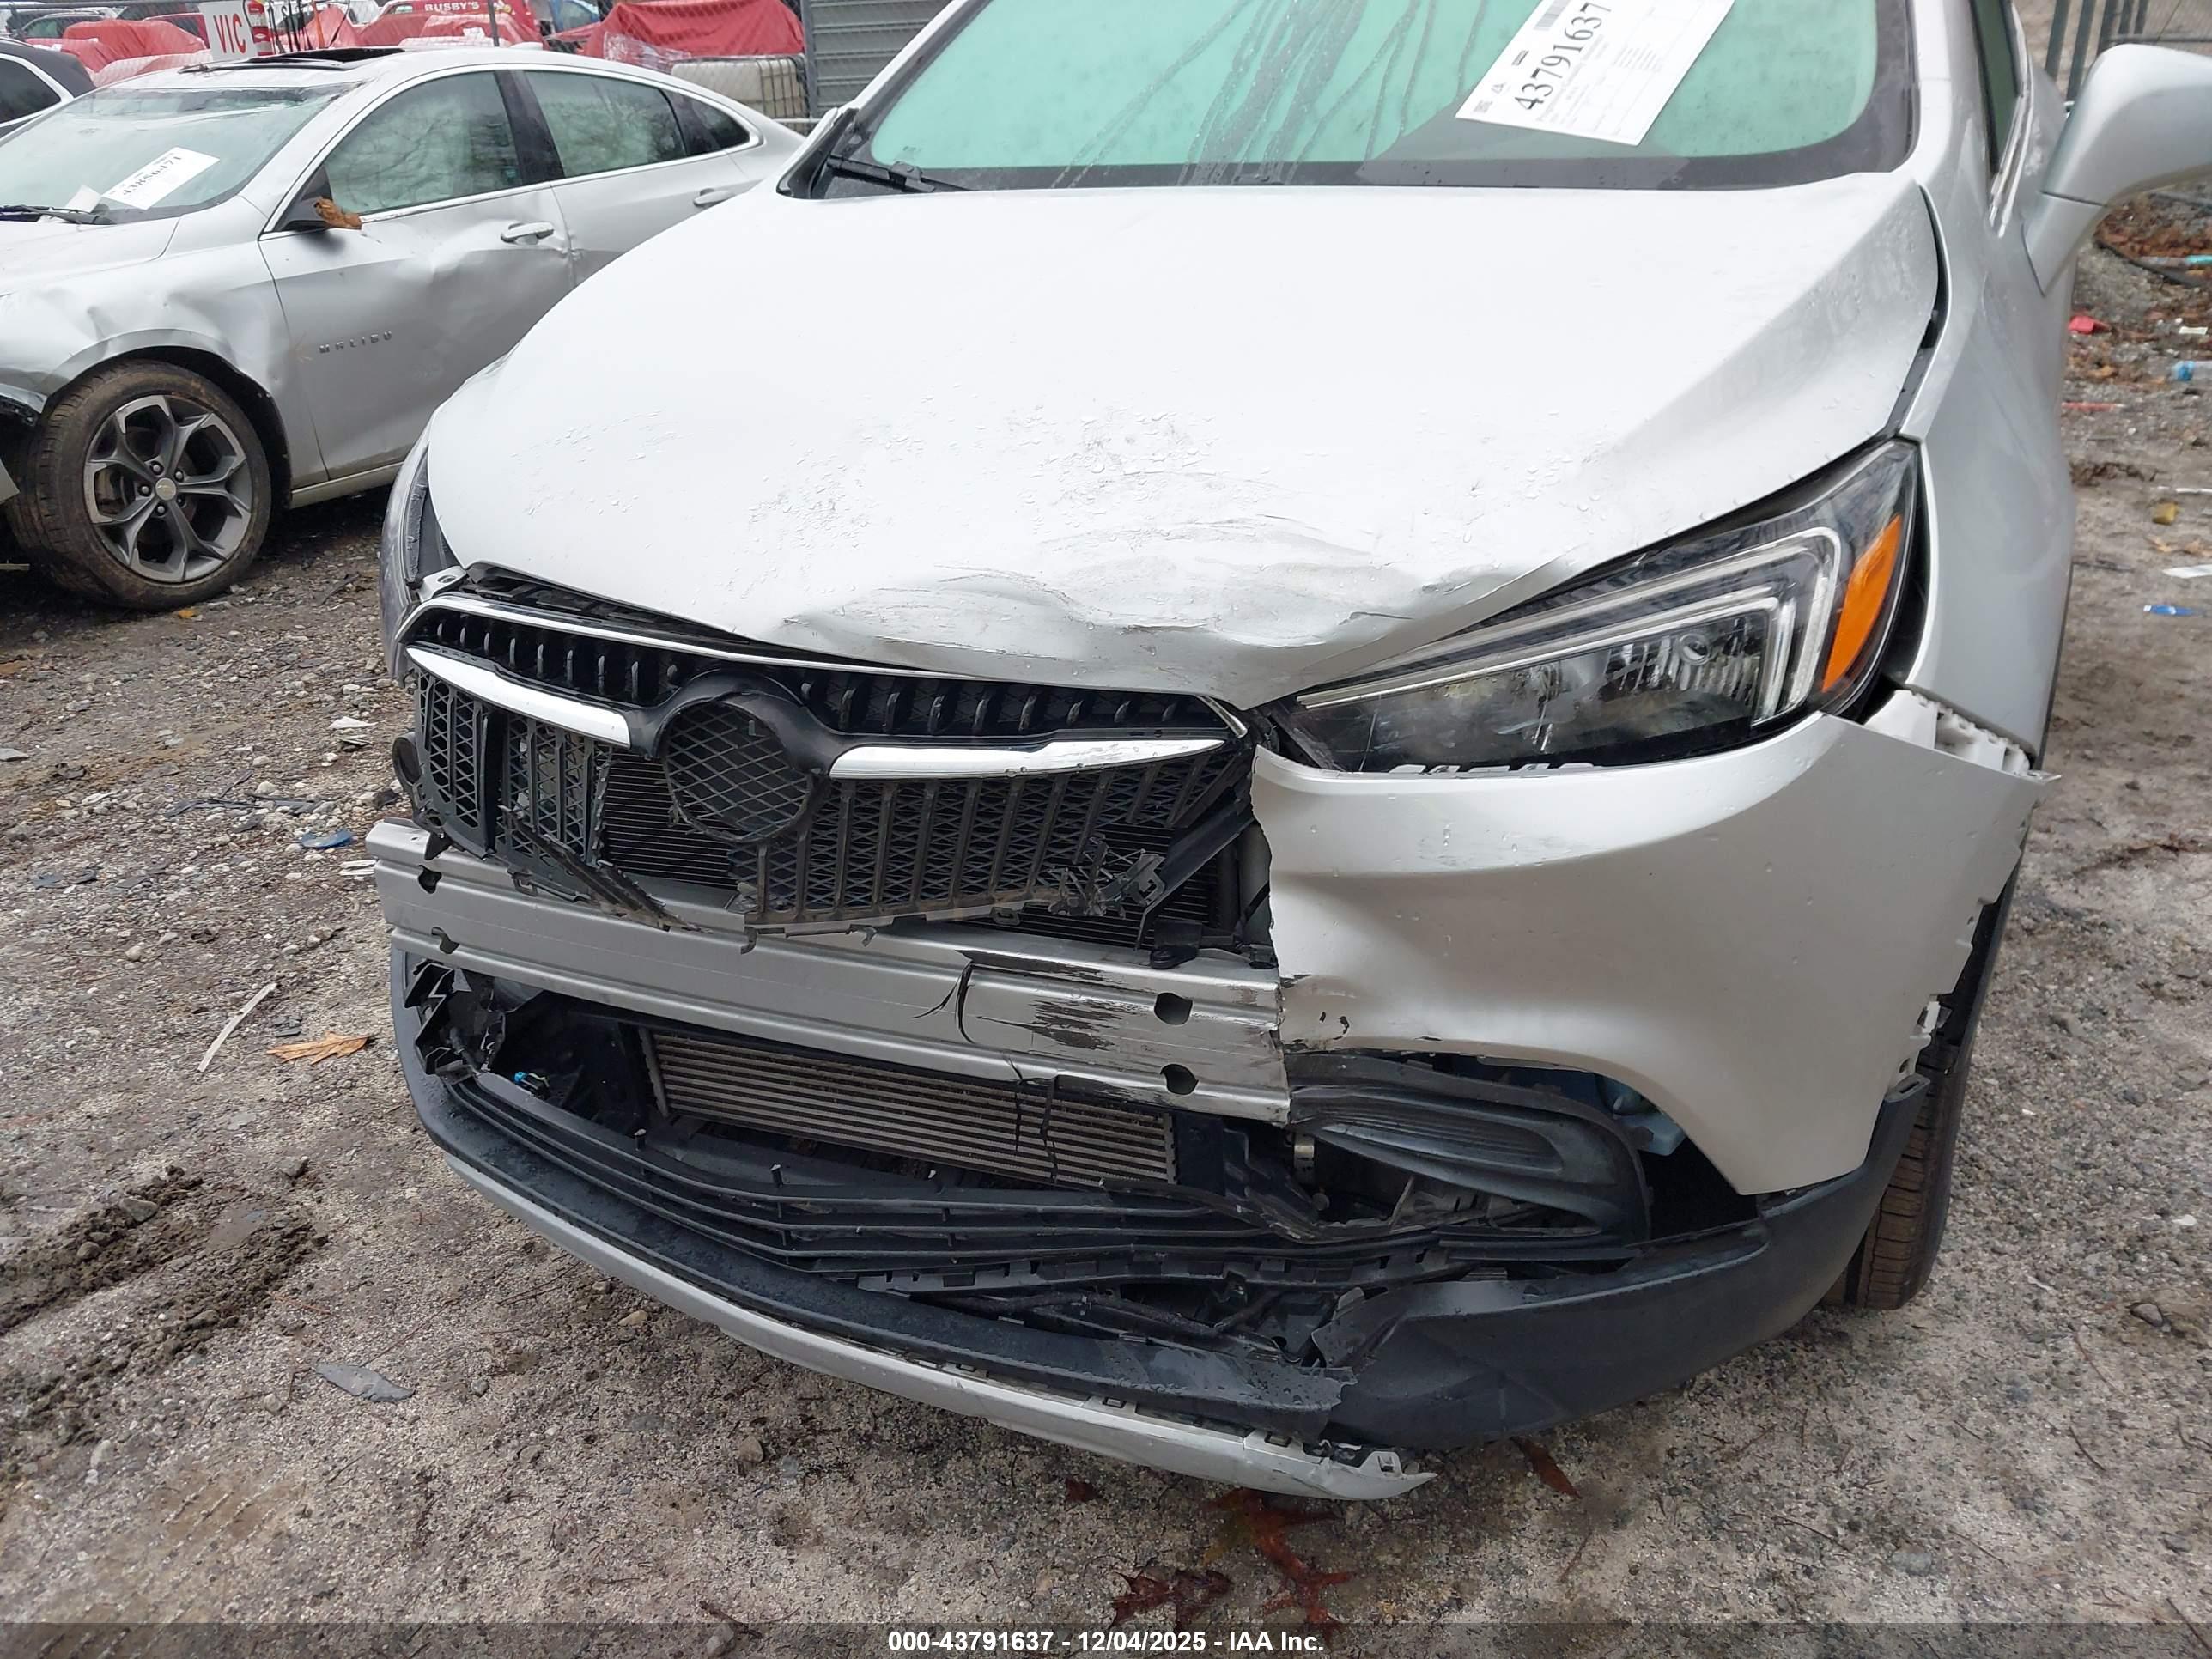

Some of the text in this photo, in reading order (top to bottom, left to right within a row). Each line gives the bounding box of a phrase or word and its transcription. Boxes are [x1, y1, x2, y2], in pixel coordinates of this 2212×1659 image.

[212, 13, 246, 53] VIC
[1514, 2, 1612, 110] 43791637
[319, 331, 392, 354] MALIBU
